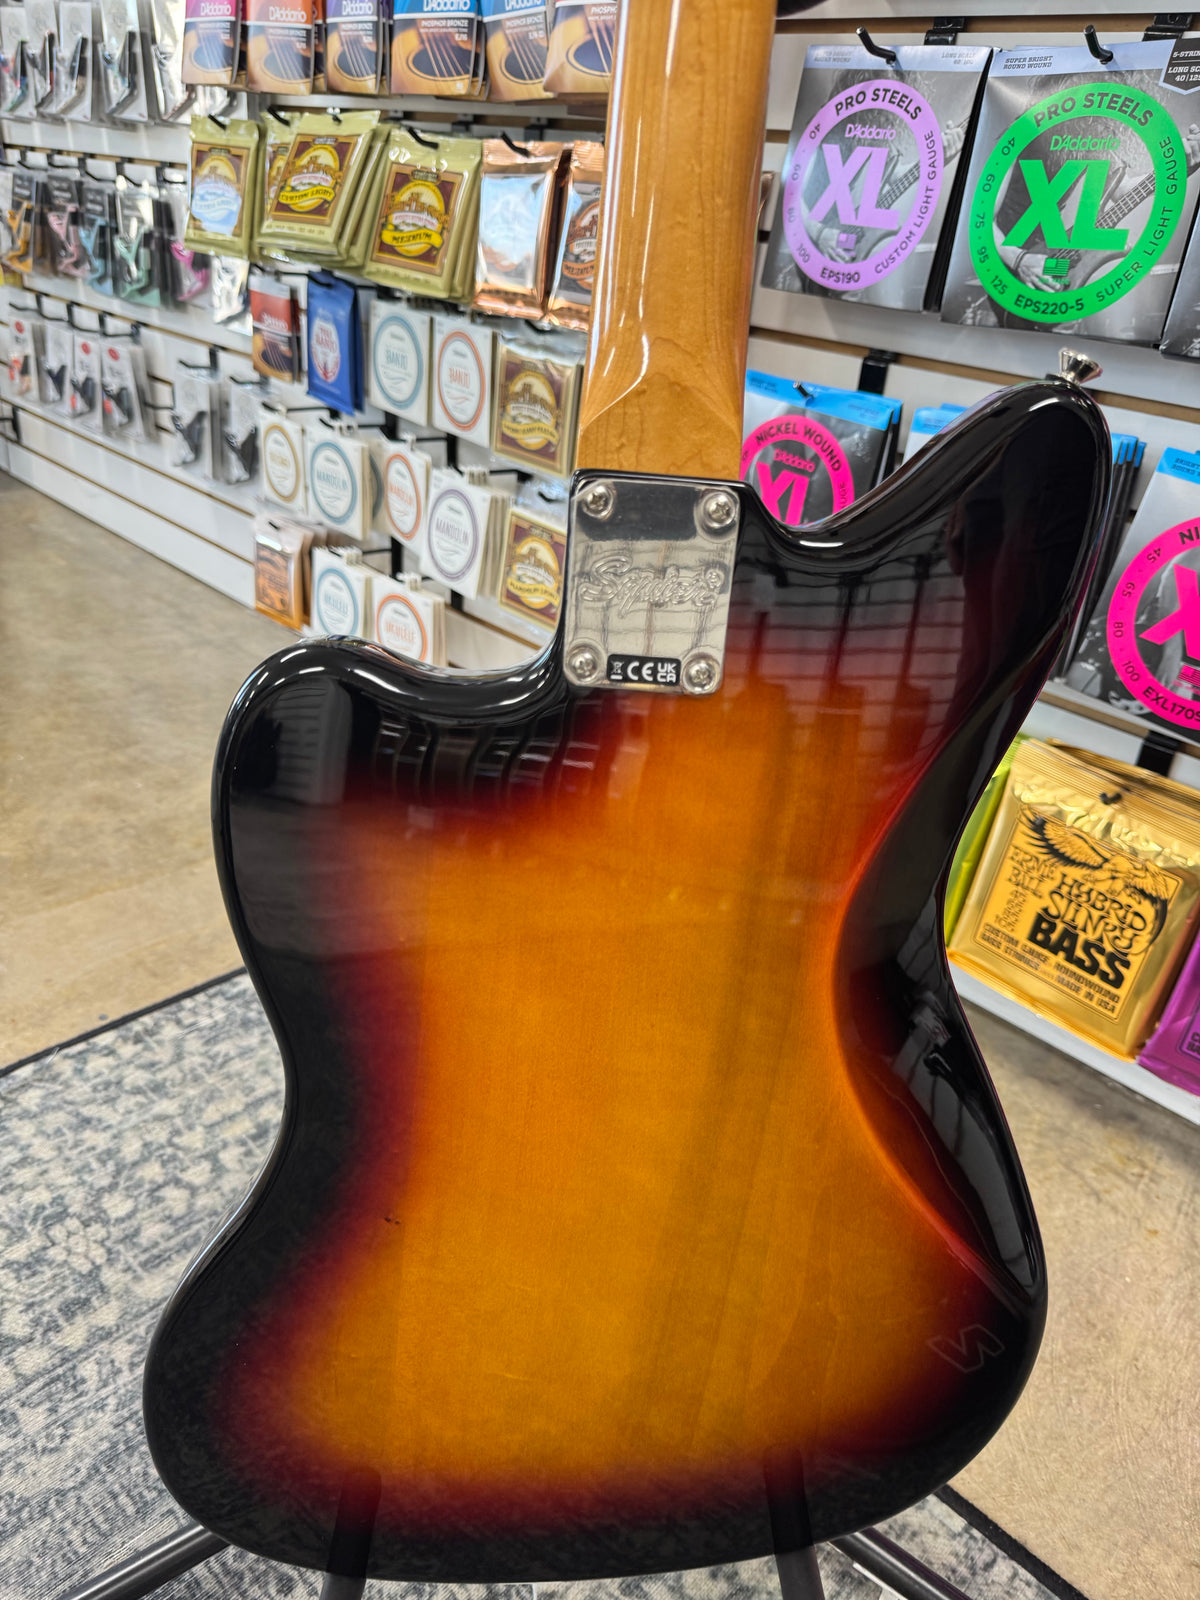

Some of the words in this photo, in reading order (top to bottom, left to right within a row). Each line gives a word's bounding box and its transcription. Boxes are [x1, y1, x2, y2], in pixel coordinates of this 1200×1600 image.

[1168, 66, 1189, 74] LONG
[834, 90, 867, 117] PRO
[871, 87, 922, 120] STEELS
[1033, 96, 1076, 128] PRO
[1083, 92, 1154, 127] STEELS
[809, 123, 821, 140] 40
[845, 123, 897, 140] D'Addario
[1001, 137, 1015, 156] 40
[1050, 134, 1120, 151] D'Addario
[807, 143, 901, 230] XL
[982, 173, 996, 193] 60
[874, 230, 916, 274] CUSTOM
[913, 186, 935, 228] LIGHT
[924, 130, 937, 180] GAUGE
[1001, 159, 1129, 251] XL
[974, 213, 986, 229] 75
[1096, 260, 1143, 302] SUPER
[1144, 206, 1174, 257] LIGHT
[1159, 136, 1178, 195] GAUGE
[977, 245, 990, 264] 95
[820, 267, 861, 284] EPS190
[989, 275, 1009, 296] 125
[1014, 294, 1084, 315] EPS220-5
[756, 422, 799, 446] NICKEL
[804, 425, 842, 471] WOUND
[774, 448, 816, 473] D'Addario
[1146, 547, 1162, 563] 45
[579, 554, 717, 618] Squier
[1122, 581, 1136, 598] 65
[1113, 621, 1124, 638] 80
[627, 661, 654, 681] CE
[657, 662, 677, 673] UK
[1122, 660, 1141, 682] 100
[656, 673, 677, 684] CA
[1008, 866, 1042, 898] BALL
[1056, 873, 1147, 931] HYBRID
[1041, 890, 1139, 957] SLINKY
[1027, 911, 1131, 989] BASS
[1054, 963, 1120, 1004] ROUNDWOUND
[1056, 975, 1083, 994] MADE
[1083, 990, 1095, 1001] IN
[1097, 998, 1116, 1014] USA
